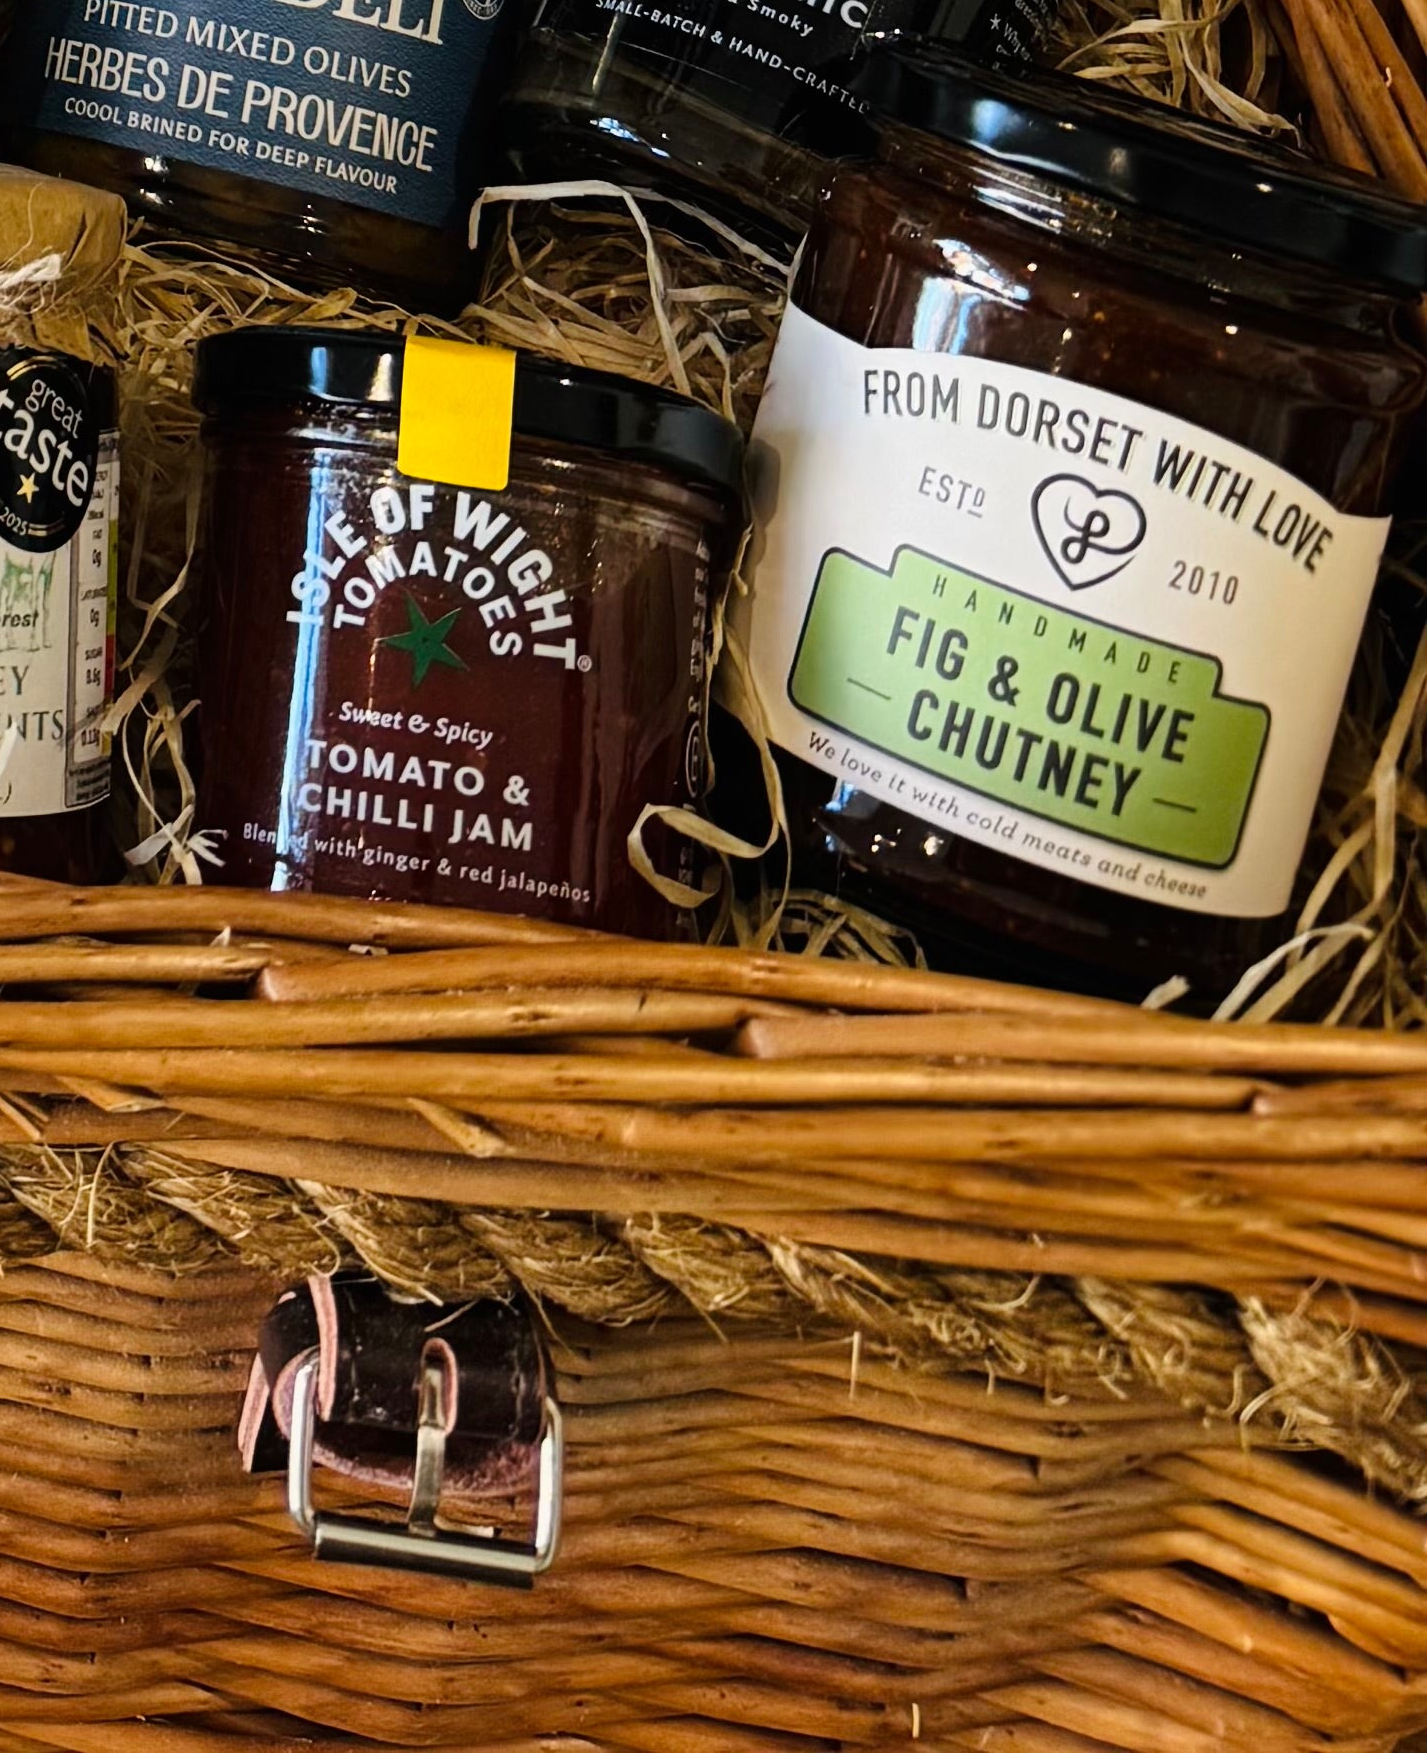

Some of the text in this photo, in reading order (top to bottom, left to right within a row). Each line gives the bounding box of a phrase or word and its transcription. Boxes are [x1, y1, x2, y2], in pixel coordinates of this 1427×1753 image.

[185, 15, 296, 65] MIXED
[303, 45, 413, 98] OLIVES
[886, 605, 1196, 764] FIG & OLIVE
[305, 740, 531, 807] TOMATO &
[906, 689, 1141, 818] CHUTNEY
[297, 783, 534, 852] CHILLI JAM
